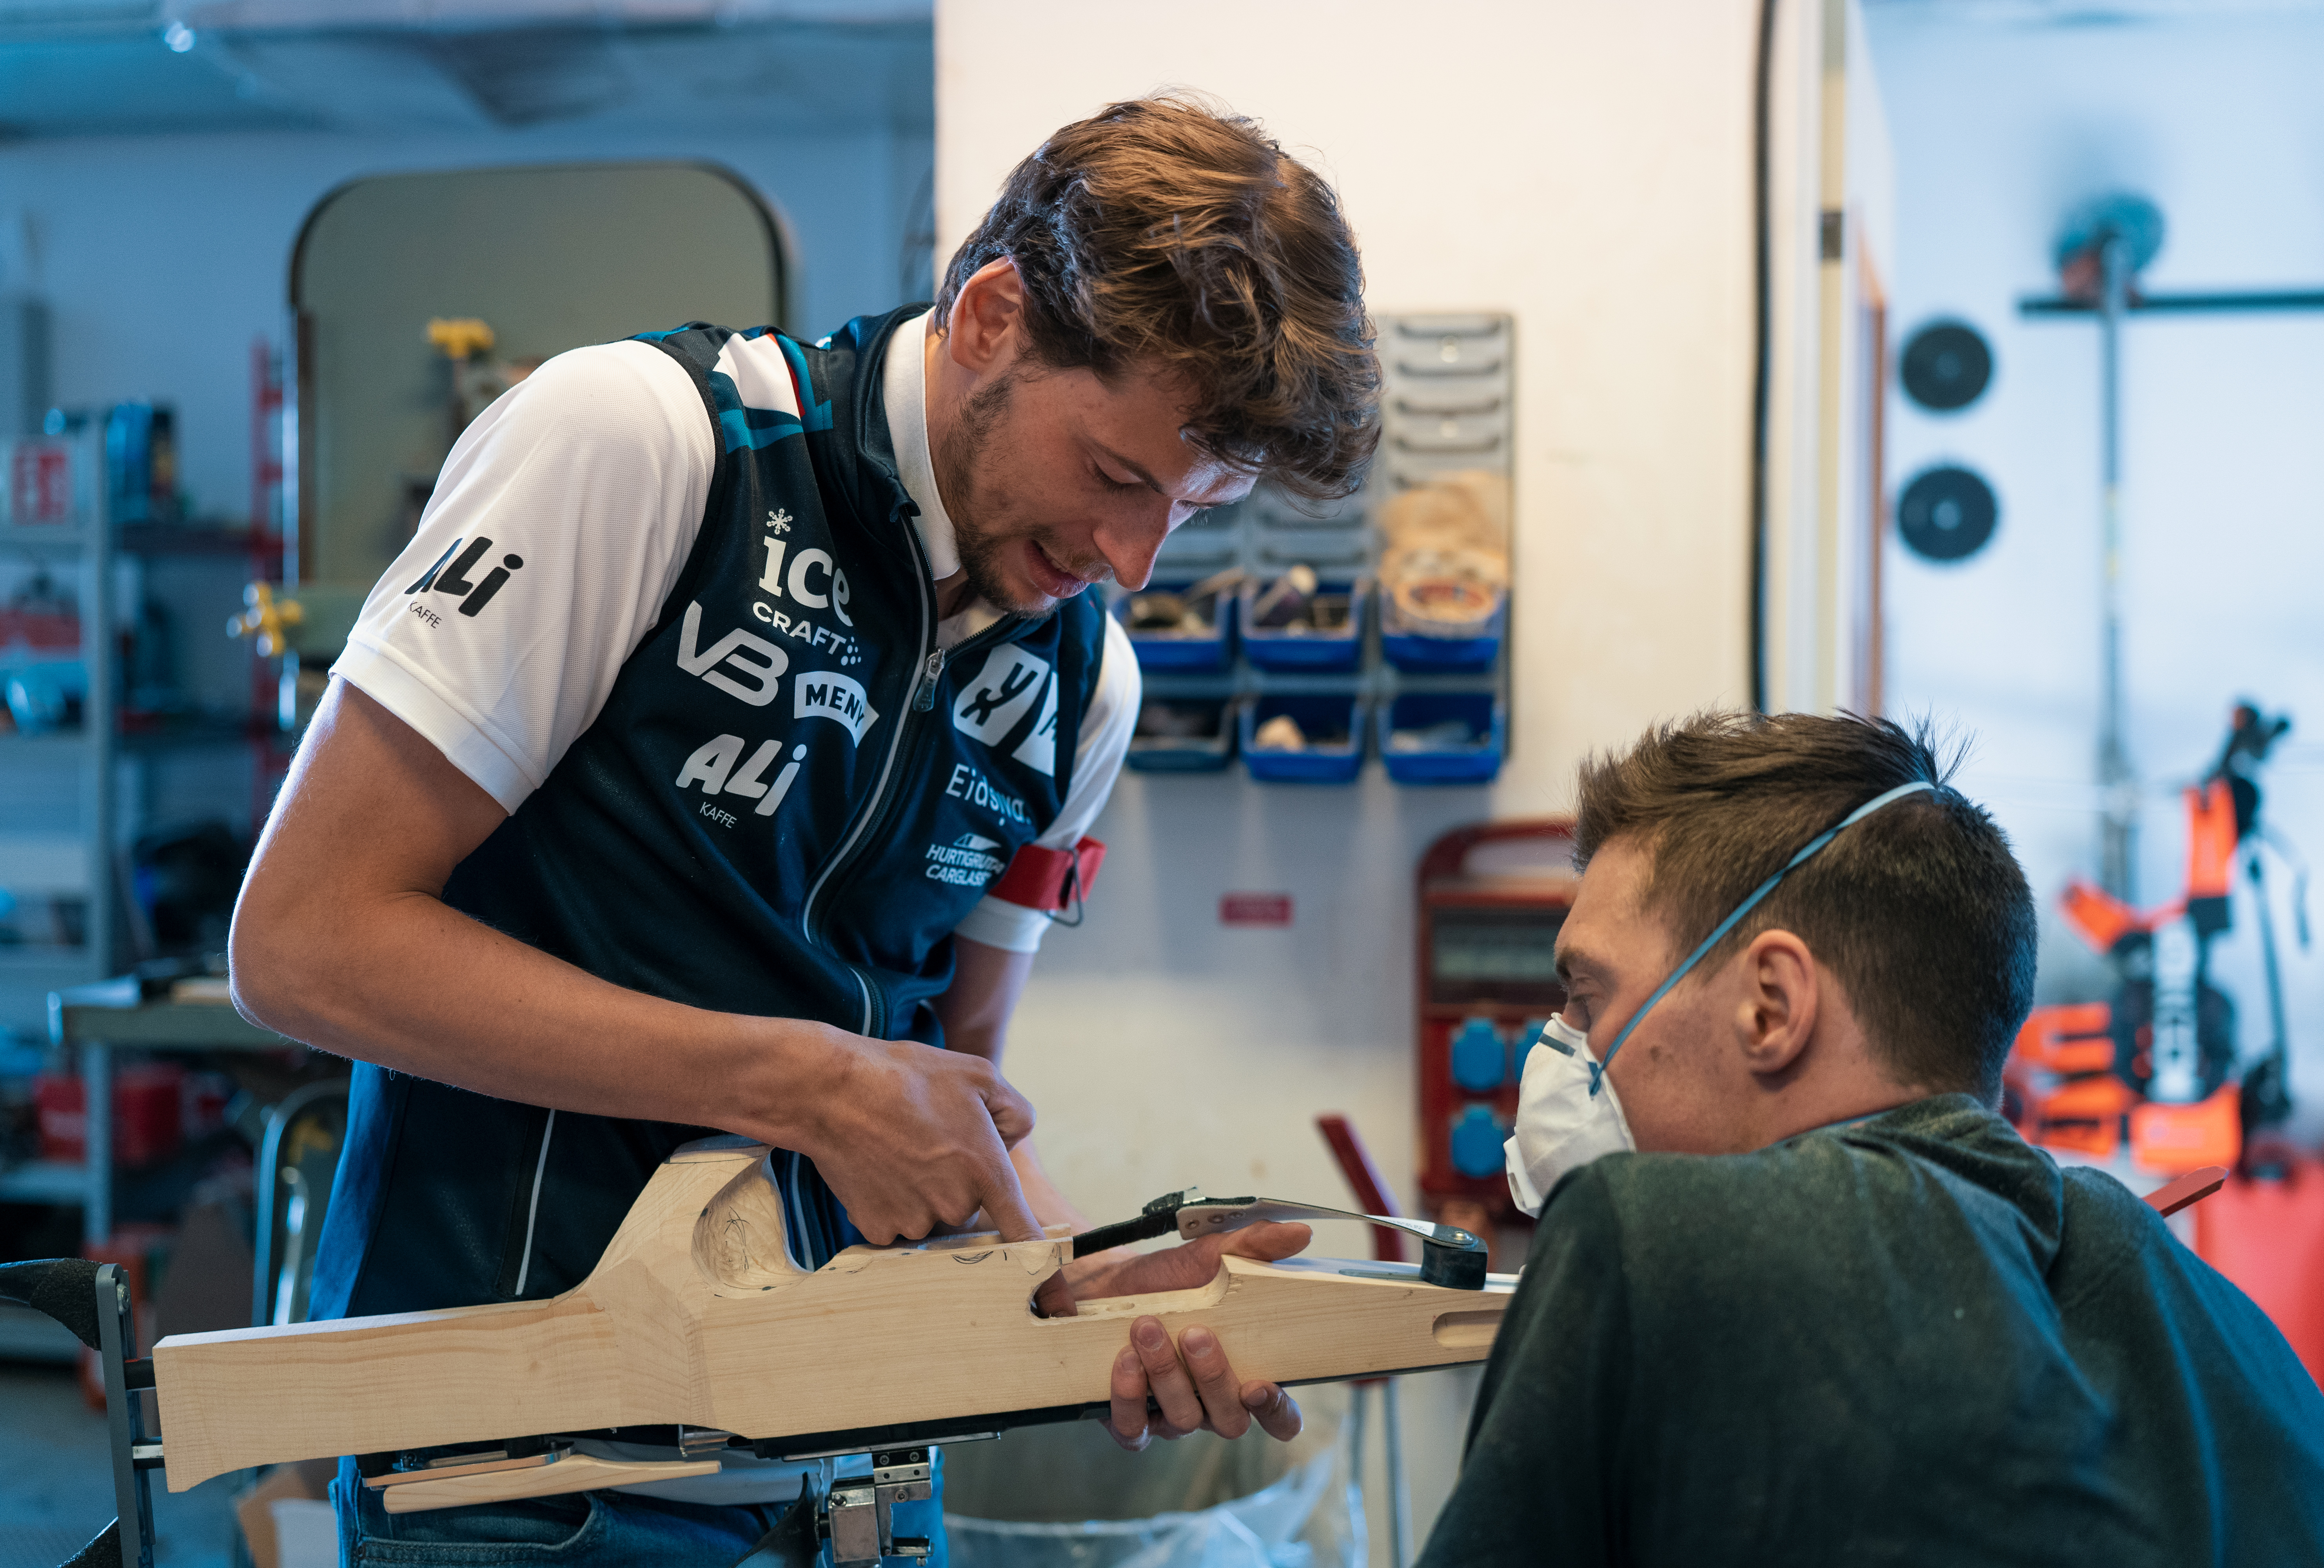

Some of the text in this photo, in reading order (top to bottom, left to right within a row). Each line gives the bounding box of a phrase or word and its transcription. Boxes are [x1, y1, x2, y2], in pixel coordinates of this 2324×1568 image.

[677, 600, 789, 706] VB
[753, 602, 847, 655] CRAFT
[699, 802, 737, 828] KAFFE
